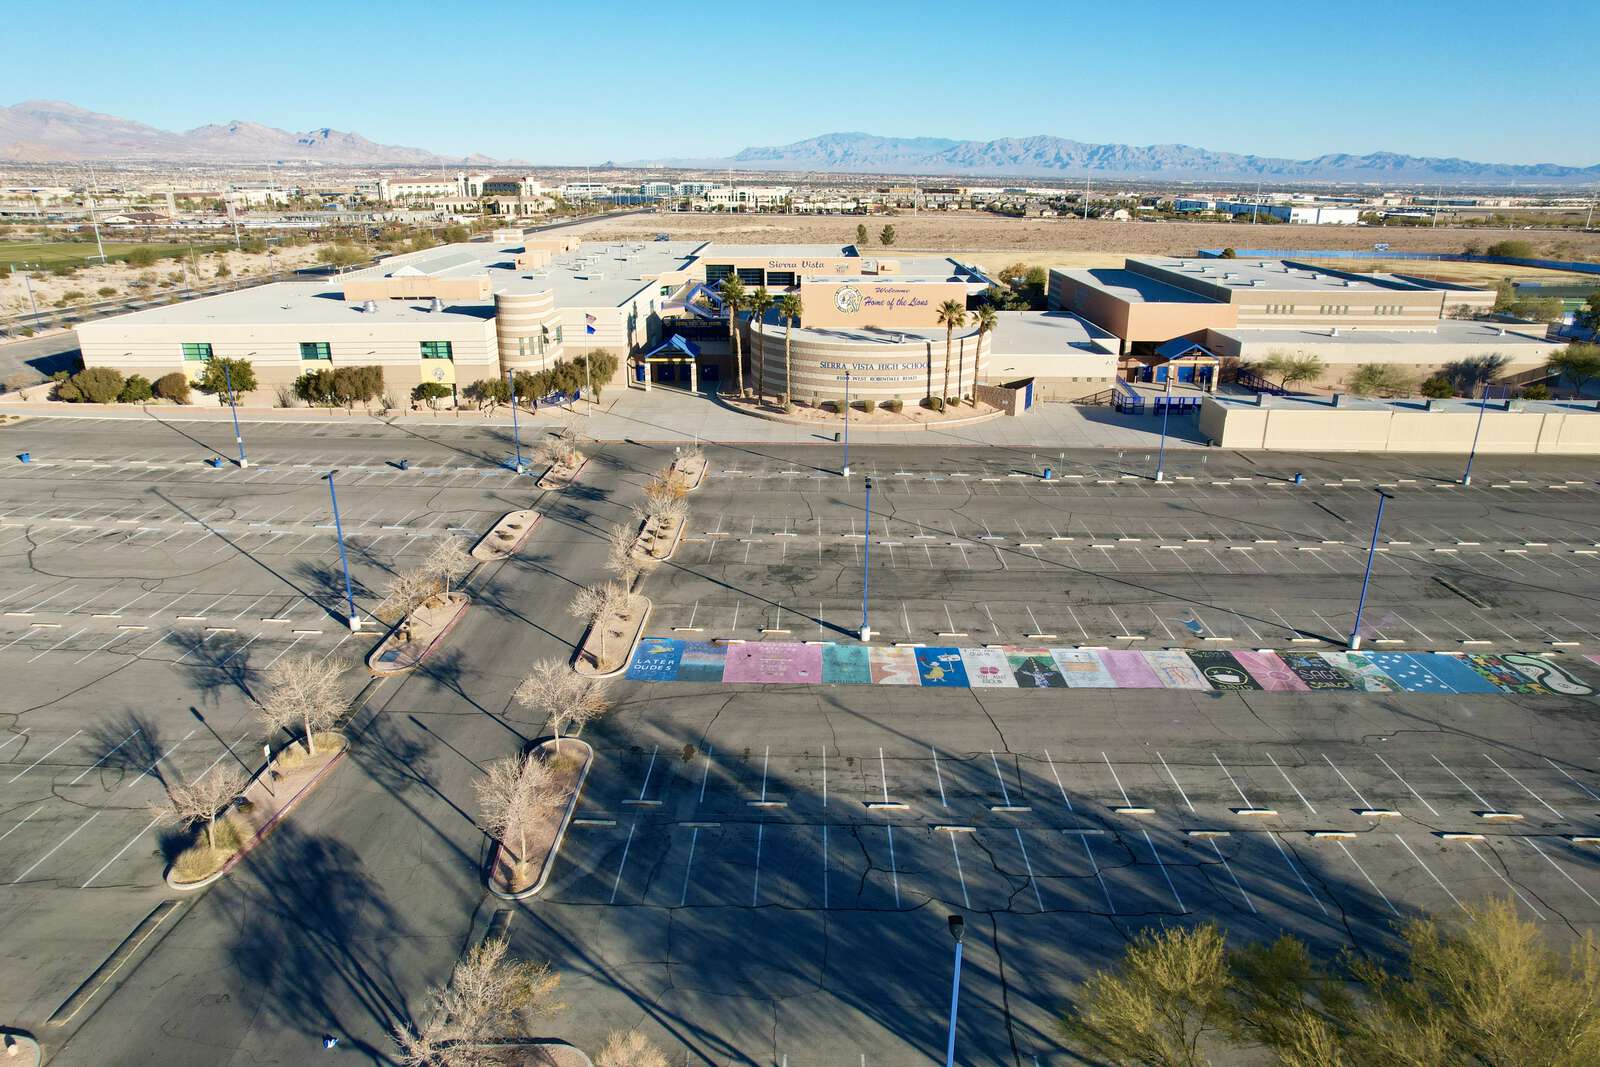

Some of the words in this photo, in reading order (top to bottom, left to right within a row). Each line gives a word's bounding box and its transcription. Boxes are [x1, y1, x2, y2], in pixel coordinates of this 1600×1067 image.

[768, 260, 797, 269] Sierra
[801, 260, 825, 269] Vista
[864, 296, 885, 307] Home
[886, 297, 896, 311] of
[896, 297, 906, 307] the
[908, 296, 929, 307] Lions
[819, 360, 848, 370] SIERRA
[852, 362, 874, 371] VISTA
[878, 363, 899, 371] HIGH
[902, 362, 931, 371] SCHOO
[1299, 669, 1344, 680] SAGE
